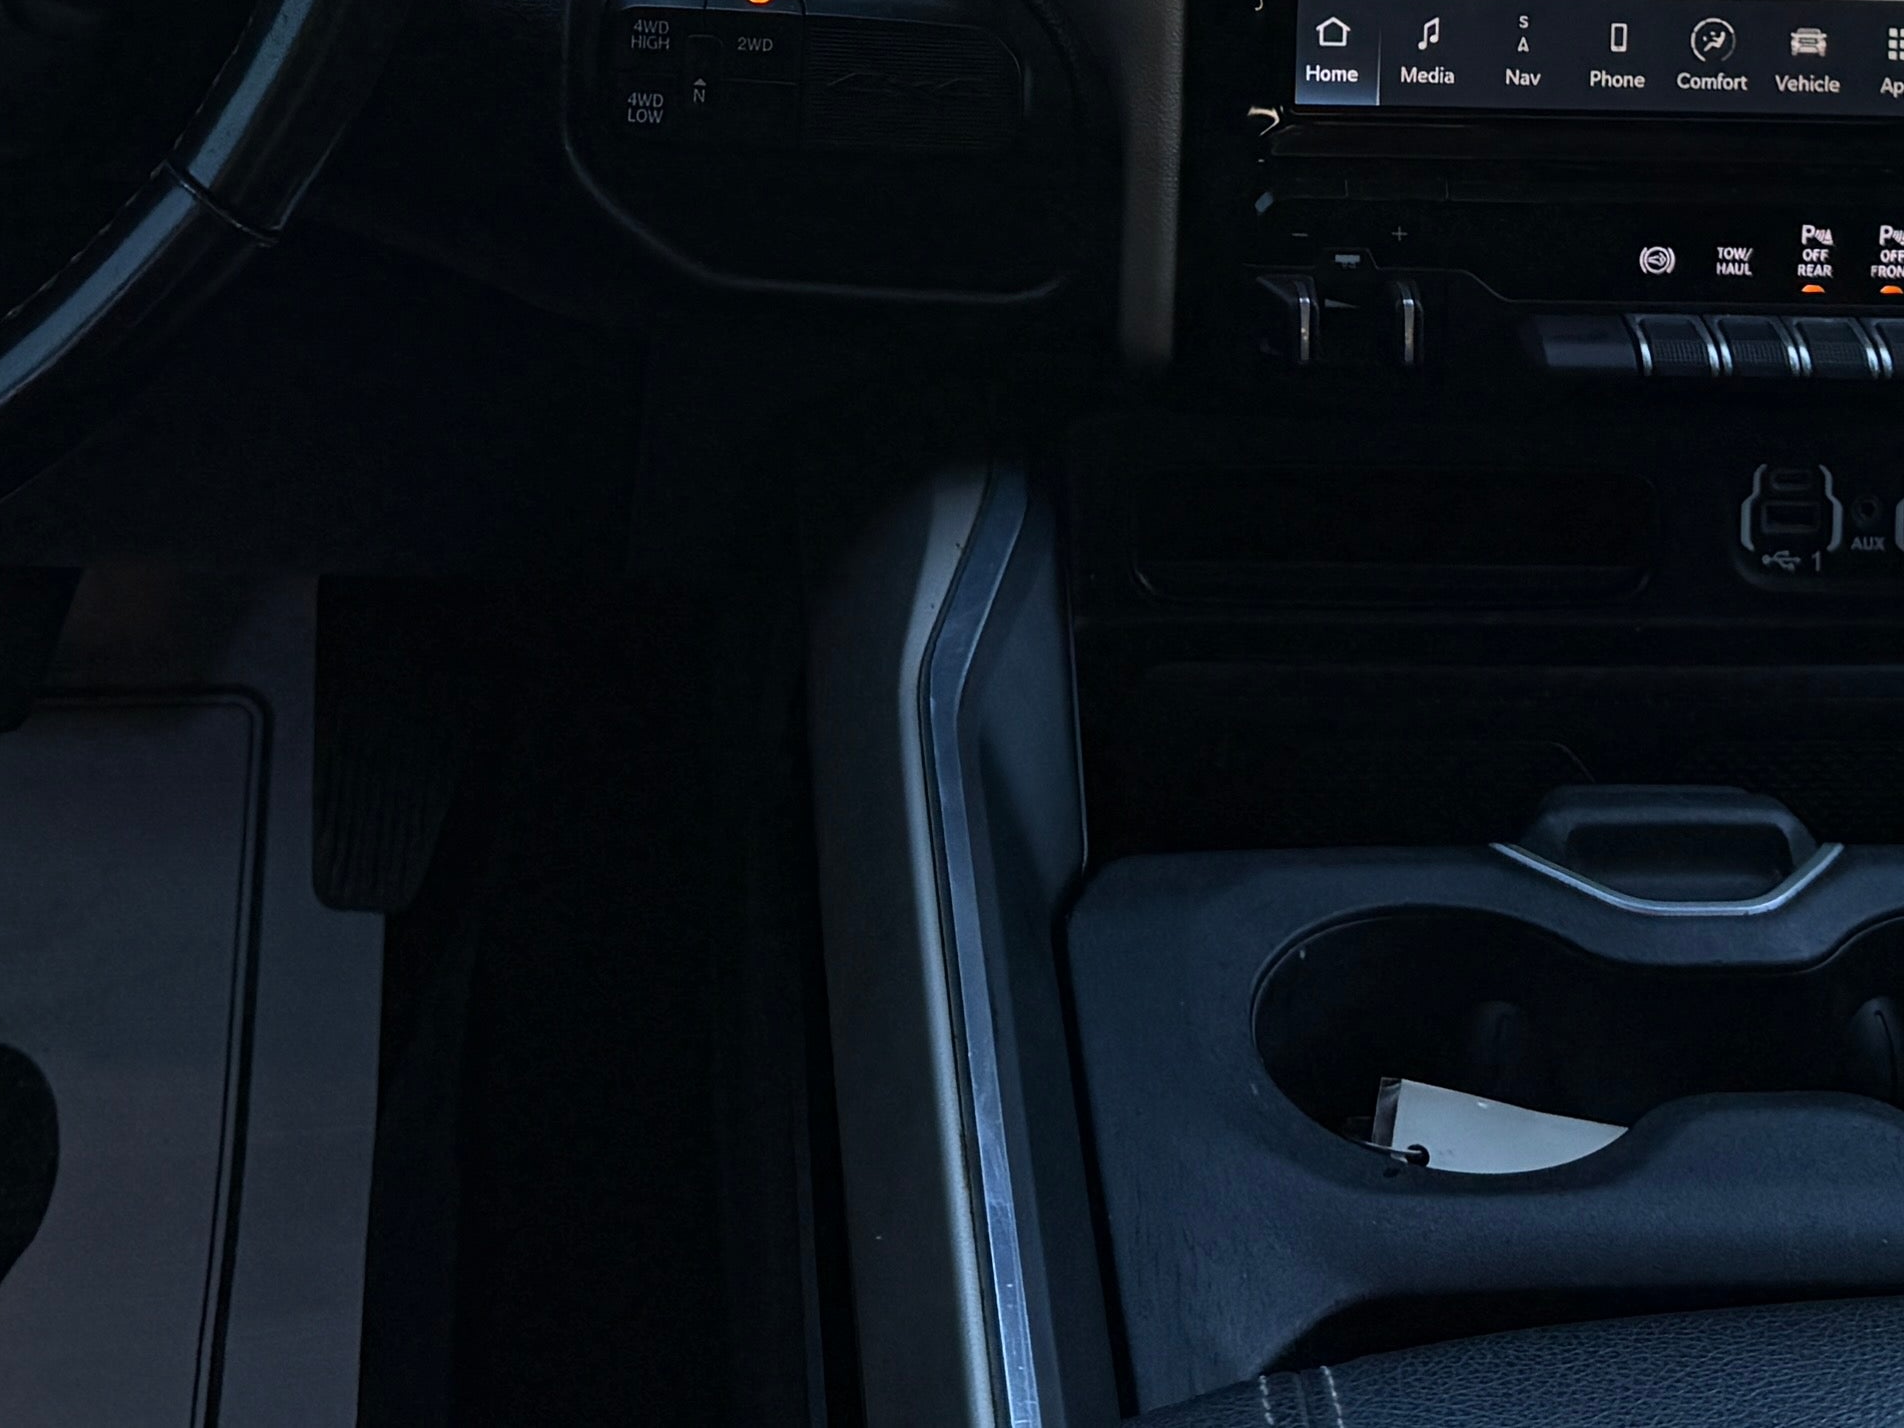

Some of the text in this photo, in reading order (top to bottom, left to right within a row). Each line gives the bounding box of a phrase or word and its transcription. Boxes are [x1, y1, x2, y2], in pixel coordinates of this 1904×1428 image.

[632, 19, 670, 35] 4WD
[630, 34, 671, 51] HIGH
[736, 36, 774, 52] 2WD
[1305, 64, 1359, 84] Home
[1400, 66, 1456, 85] Media
[1505, 68, 1542, 87] Nav
[1589, 70, 1646, 89] Phone
[1676, 72, 1748, 93] Comfort
[1774, 74, 1841, 94] Vehicle
[627, 92, 665, 108] 4WD
[692, 89, 706, 103] N
[627, 108, 664, 124] LOW
[1715, 246, 1754, 261] TOW/
[1801, 248, 1830, 262] OFF
[1715, 262, 1754, 277] HAUL
[1796, 263, 1833, 278] REAR
[1850, 535, 1887, 552] AUX
[1810, 552, 1823, 573] 1
